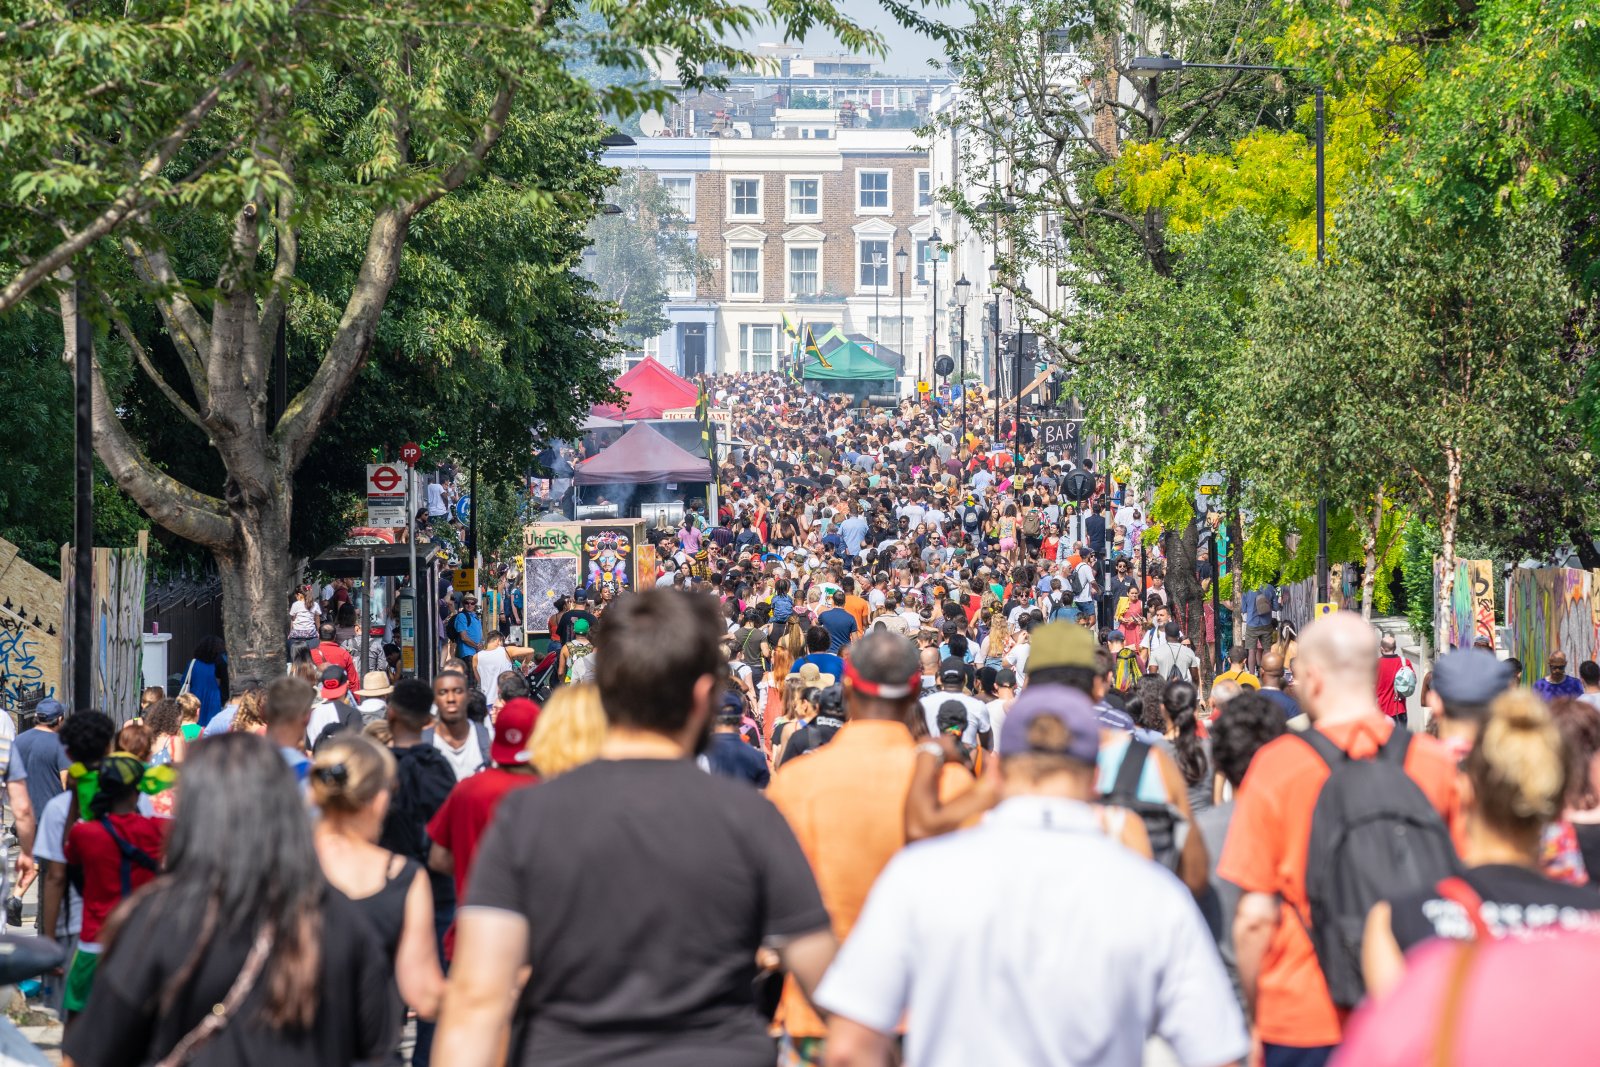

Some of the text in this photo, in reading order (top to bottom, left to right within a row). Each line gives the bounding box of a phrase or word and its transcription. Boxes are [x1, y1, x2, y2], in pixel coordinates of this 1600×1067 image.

[1046, 422, 1075, 443] BAR
[404, 448, 417, 458] PP
[525, 533, 568, 546] Urinals
